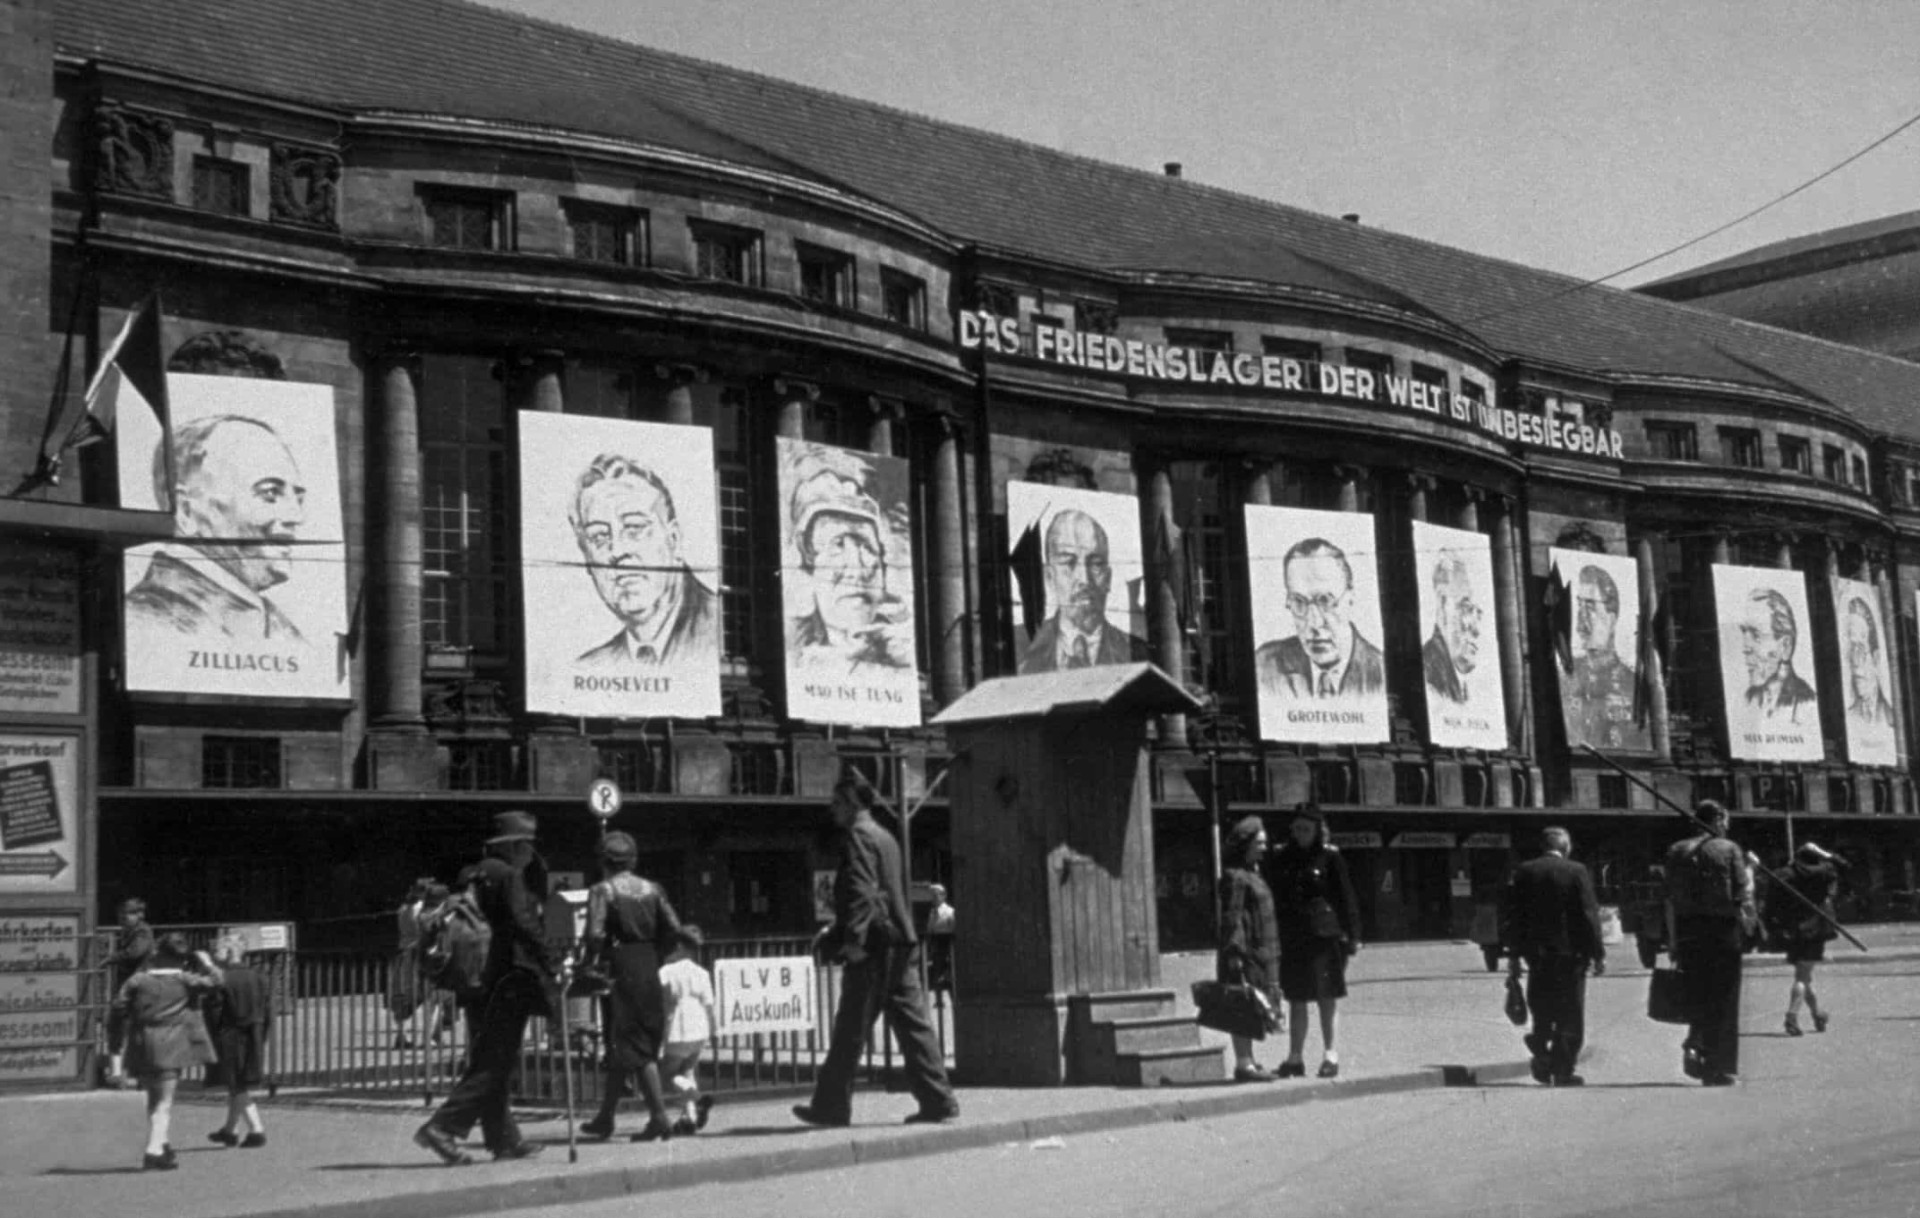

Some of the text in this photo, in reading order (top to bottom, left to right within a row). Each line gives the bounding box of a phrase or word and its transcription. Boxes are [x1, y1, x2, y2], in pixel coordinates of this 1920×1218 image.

[960, 309, 1625, 460] DAS FRIEDENSLAGER DER WELT IST UNBESIEGBAR
[188, 650, 300, 673] ZILLIACUS
[573, 674, 673, 693] ROOSEVELT
[1287, 709, 1366, 724] GROTEWOHL
[732, 994, 803, 1023] Auskunft
